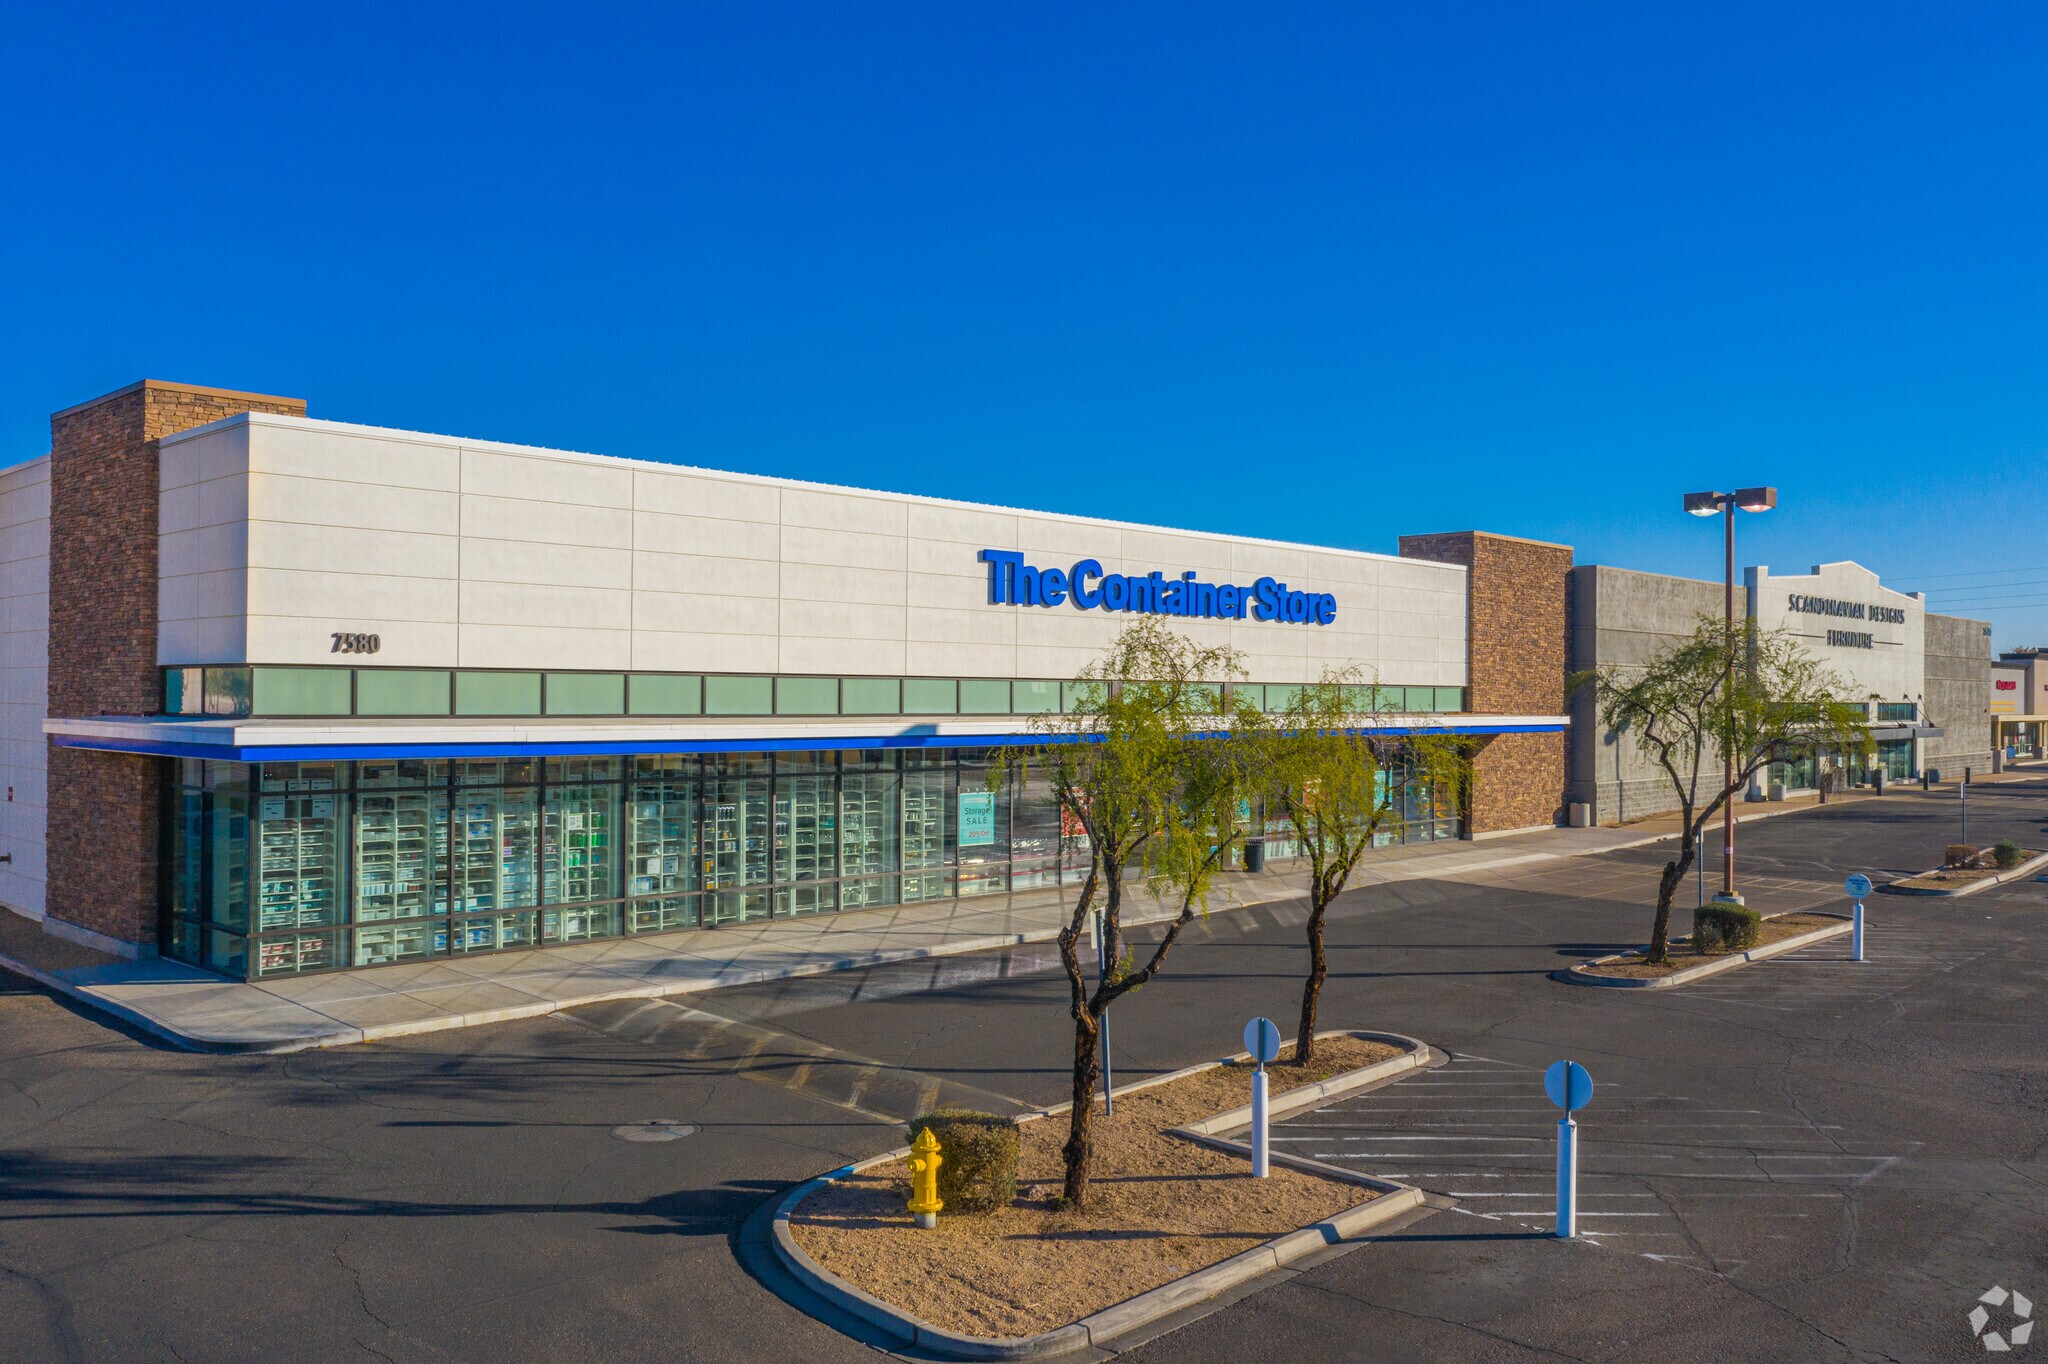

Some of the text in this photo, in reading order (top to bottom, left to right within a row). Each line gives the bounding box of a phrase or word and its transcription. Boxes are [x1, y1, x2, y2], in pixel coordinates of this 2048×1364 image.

[982, 549, 1337, 625] The Container Store
[1788, 593, 1905, 625] SCANDINAVIAN DESIGNS
[330, 632, 381, 655] 7580
[1826, 629, 1874, 650] FURNITURE
